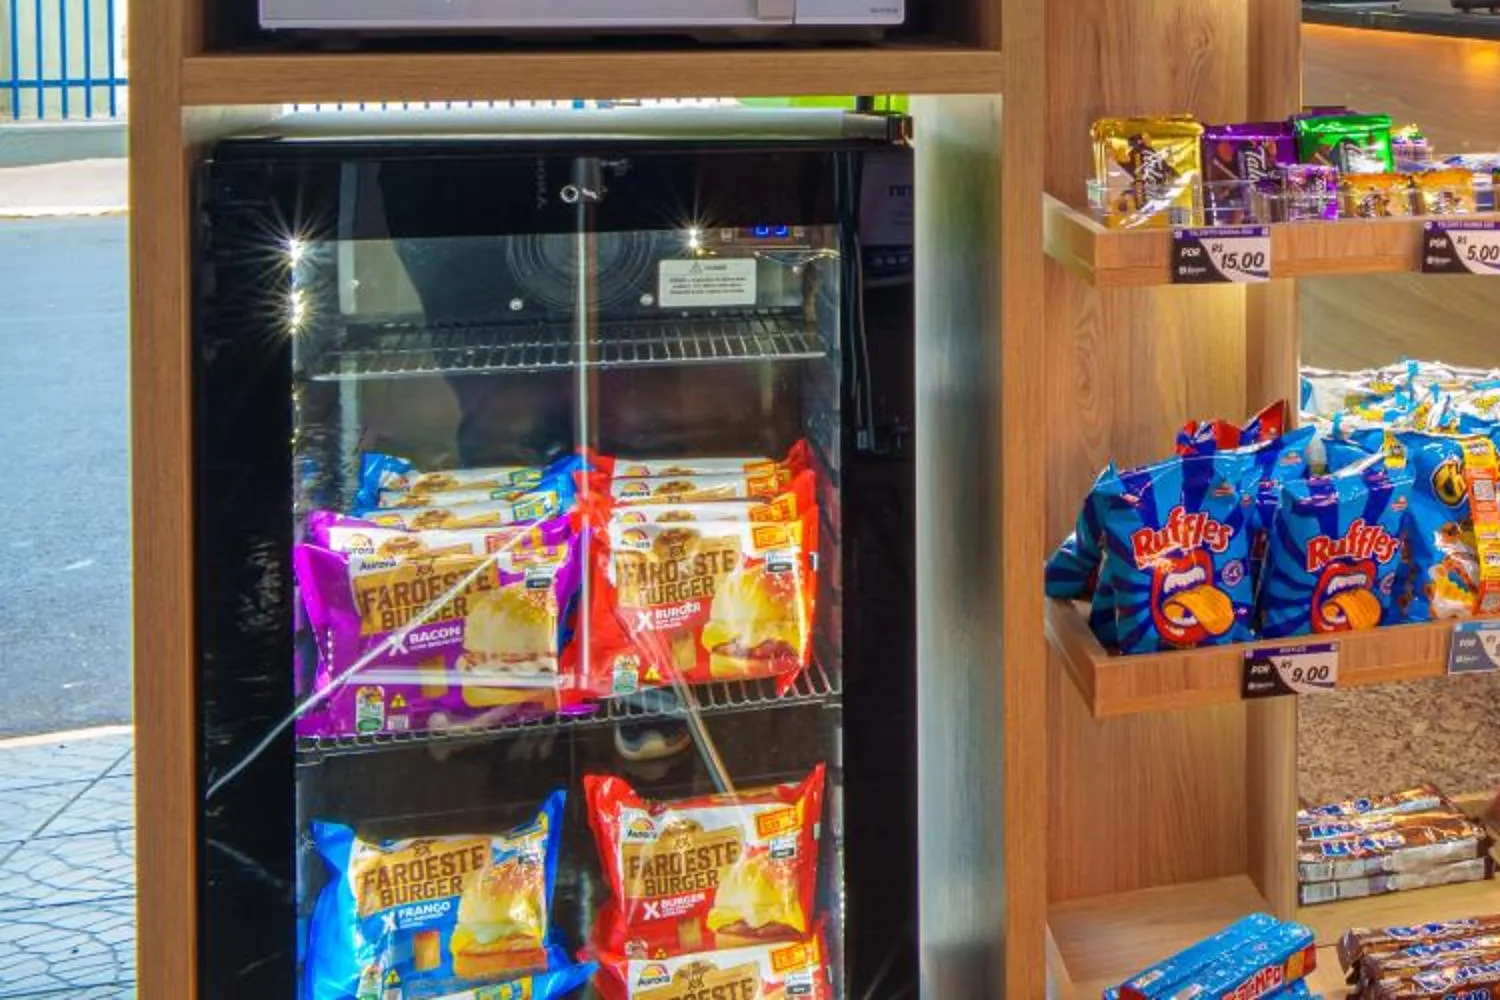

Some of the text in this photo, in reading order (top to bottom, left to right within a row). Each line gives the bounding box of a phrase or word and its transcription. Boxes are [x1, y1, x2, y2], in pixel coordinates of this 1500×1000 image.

[1181, 247, 1201, 258] POR
[1429, 237, 1448, 249] POR
[1467, 244, 1500, 261] 5,00
[1220, 251, 1265, 270] 15,00
[1131, 506, 1235, 568] Ruffles
[1306, 518, 1400, 572] Ruffles
[359, 558, 398, 571] Aurora
[637, 610, 654, 632] X
[408, 625, 462, 645] BACON
[1251, 665, 1271, 675] POR
[1291, 665, 1329, 683] 9,00
[362, 845, 486, 891] FAROESTE
[629, 841, 740, 880] FAROESTE
[380, 876, 464, 907] BURGER
[643, 869, 721, 898] BURGER
[380, 901, 452, 933] X FRANGO
[643, 891, 706, 921] X BURGER
